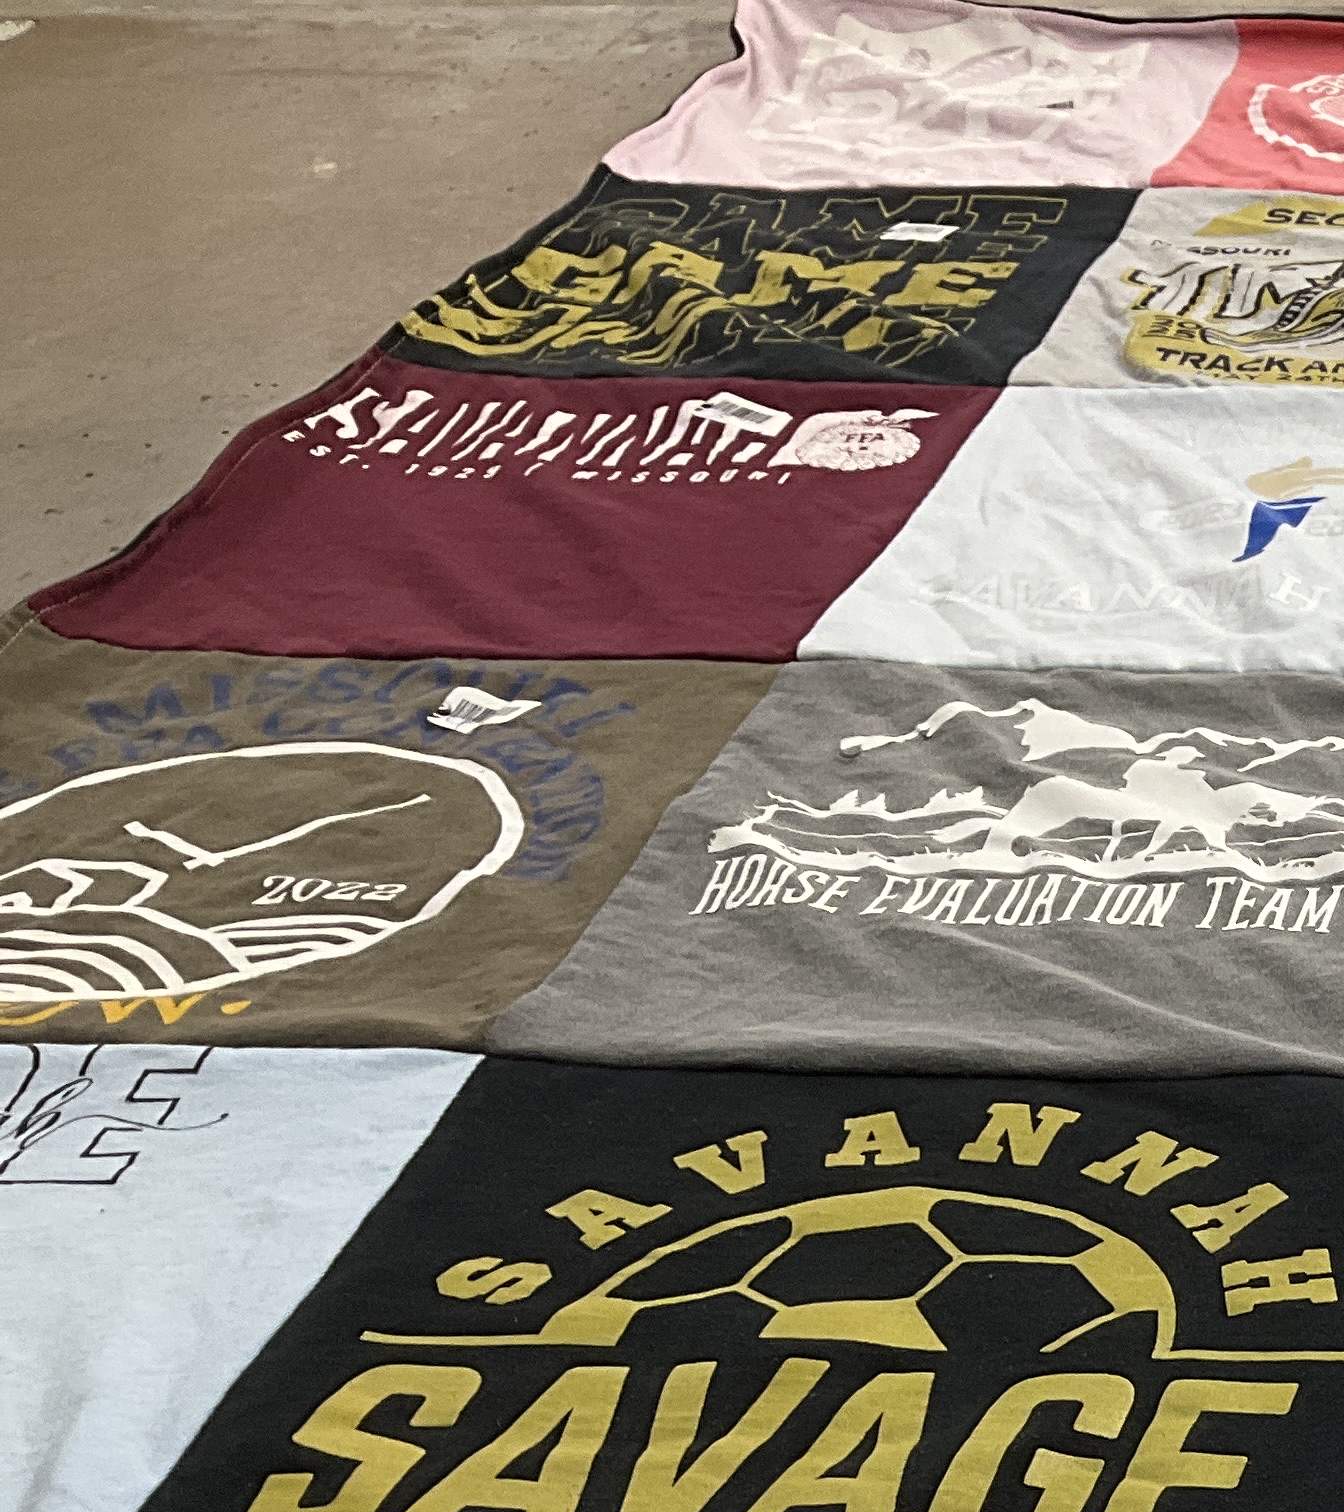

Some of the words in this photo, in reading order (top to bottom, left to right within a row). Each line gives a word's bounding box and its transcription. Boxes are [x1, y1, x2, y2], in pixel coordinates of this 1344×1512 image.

[1155, 346, 1292, 375] TRACK
[251, 874, 408, 906] 2022
[688, 856, 861, 917] HORSE
[861, 871, 1177, 930] EVALUATION
[1194, 875, 1344, 937] TEAM
[435, 1101, 1340, 1320] SAVANNAH
